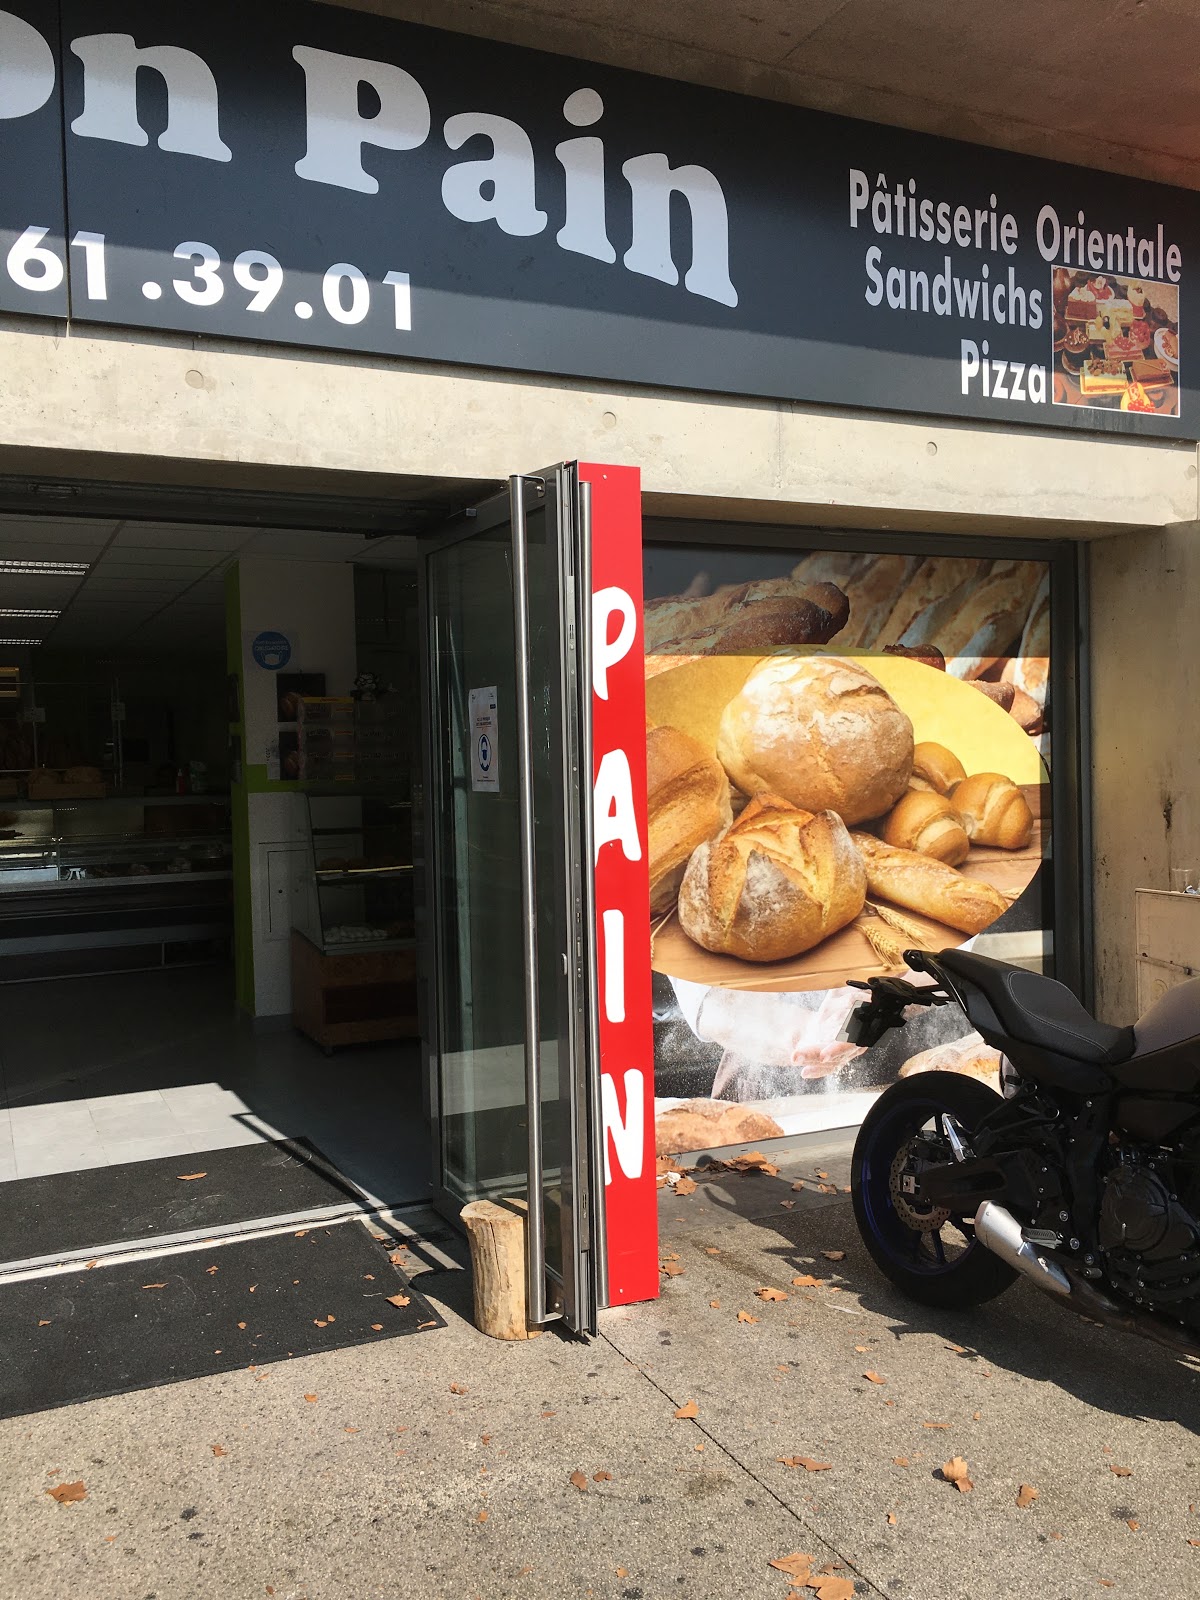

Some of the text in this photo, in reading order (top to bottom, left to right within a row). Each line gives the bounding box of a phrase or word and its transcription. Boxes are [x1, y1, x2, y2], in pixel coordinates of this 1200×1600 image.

[292, 45, 738, 308] Pain
[849, 168, 1182, 282] Pâtisserie Orientale
[865, 245, 1043, 330] Sandwichs
[960, 338, 1047, 404] Pizza
[592, 586, 644, 1187] PAIN
